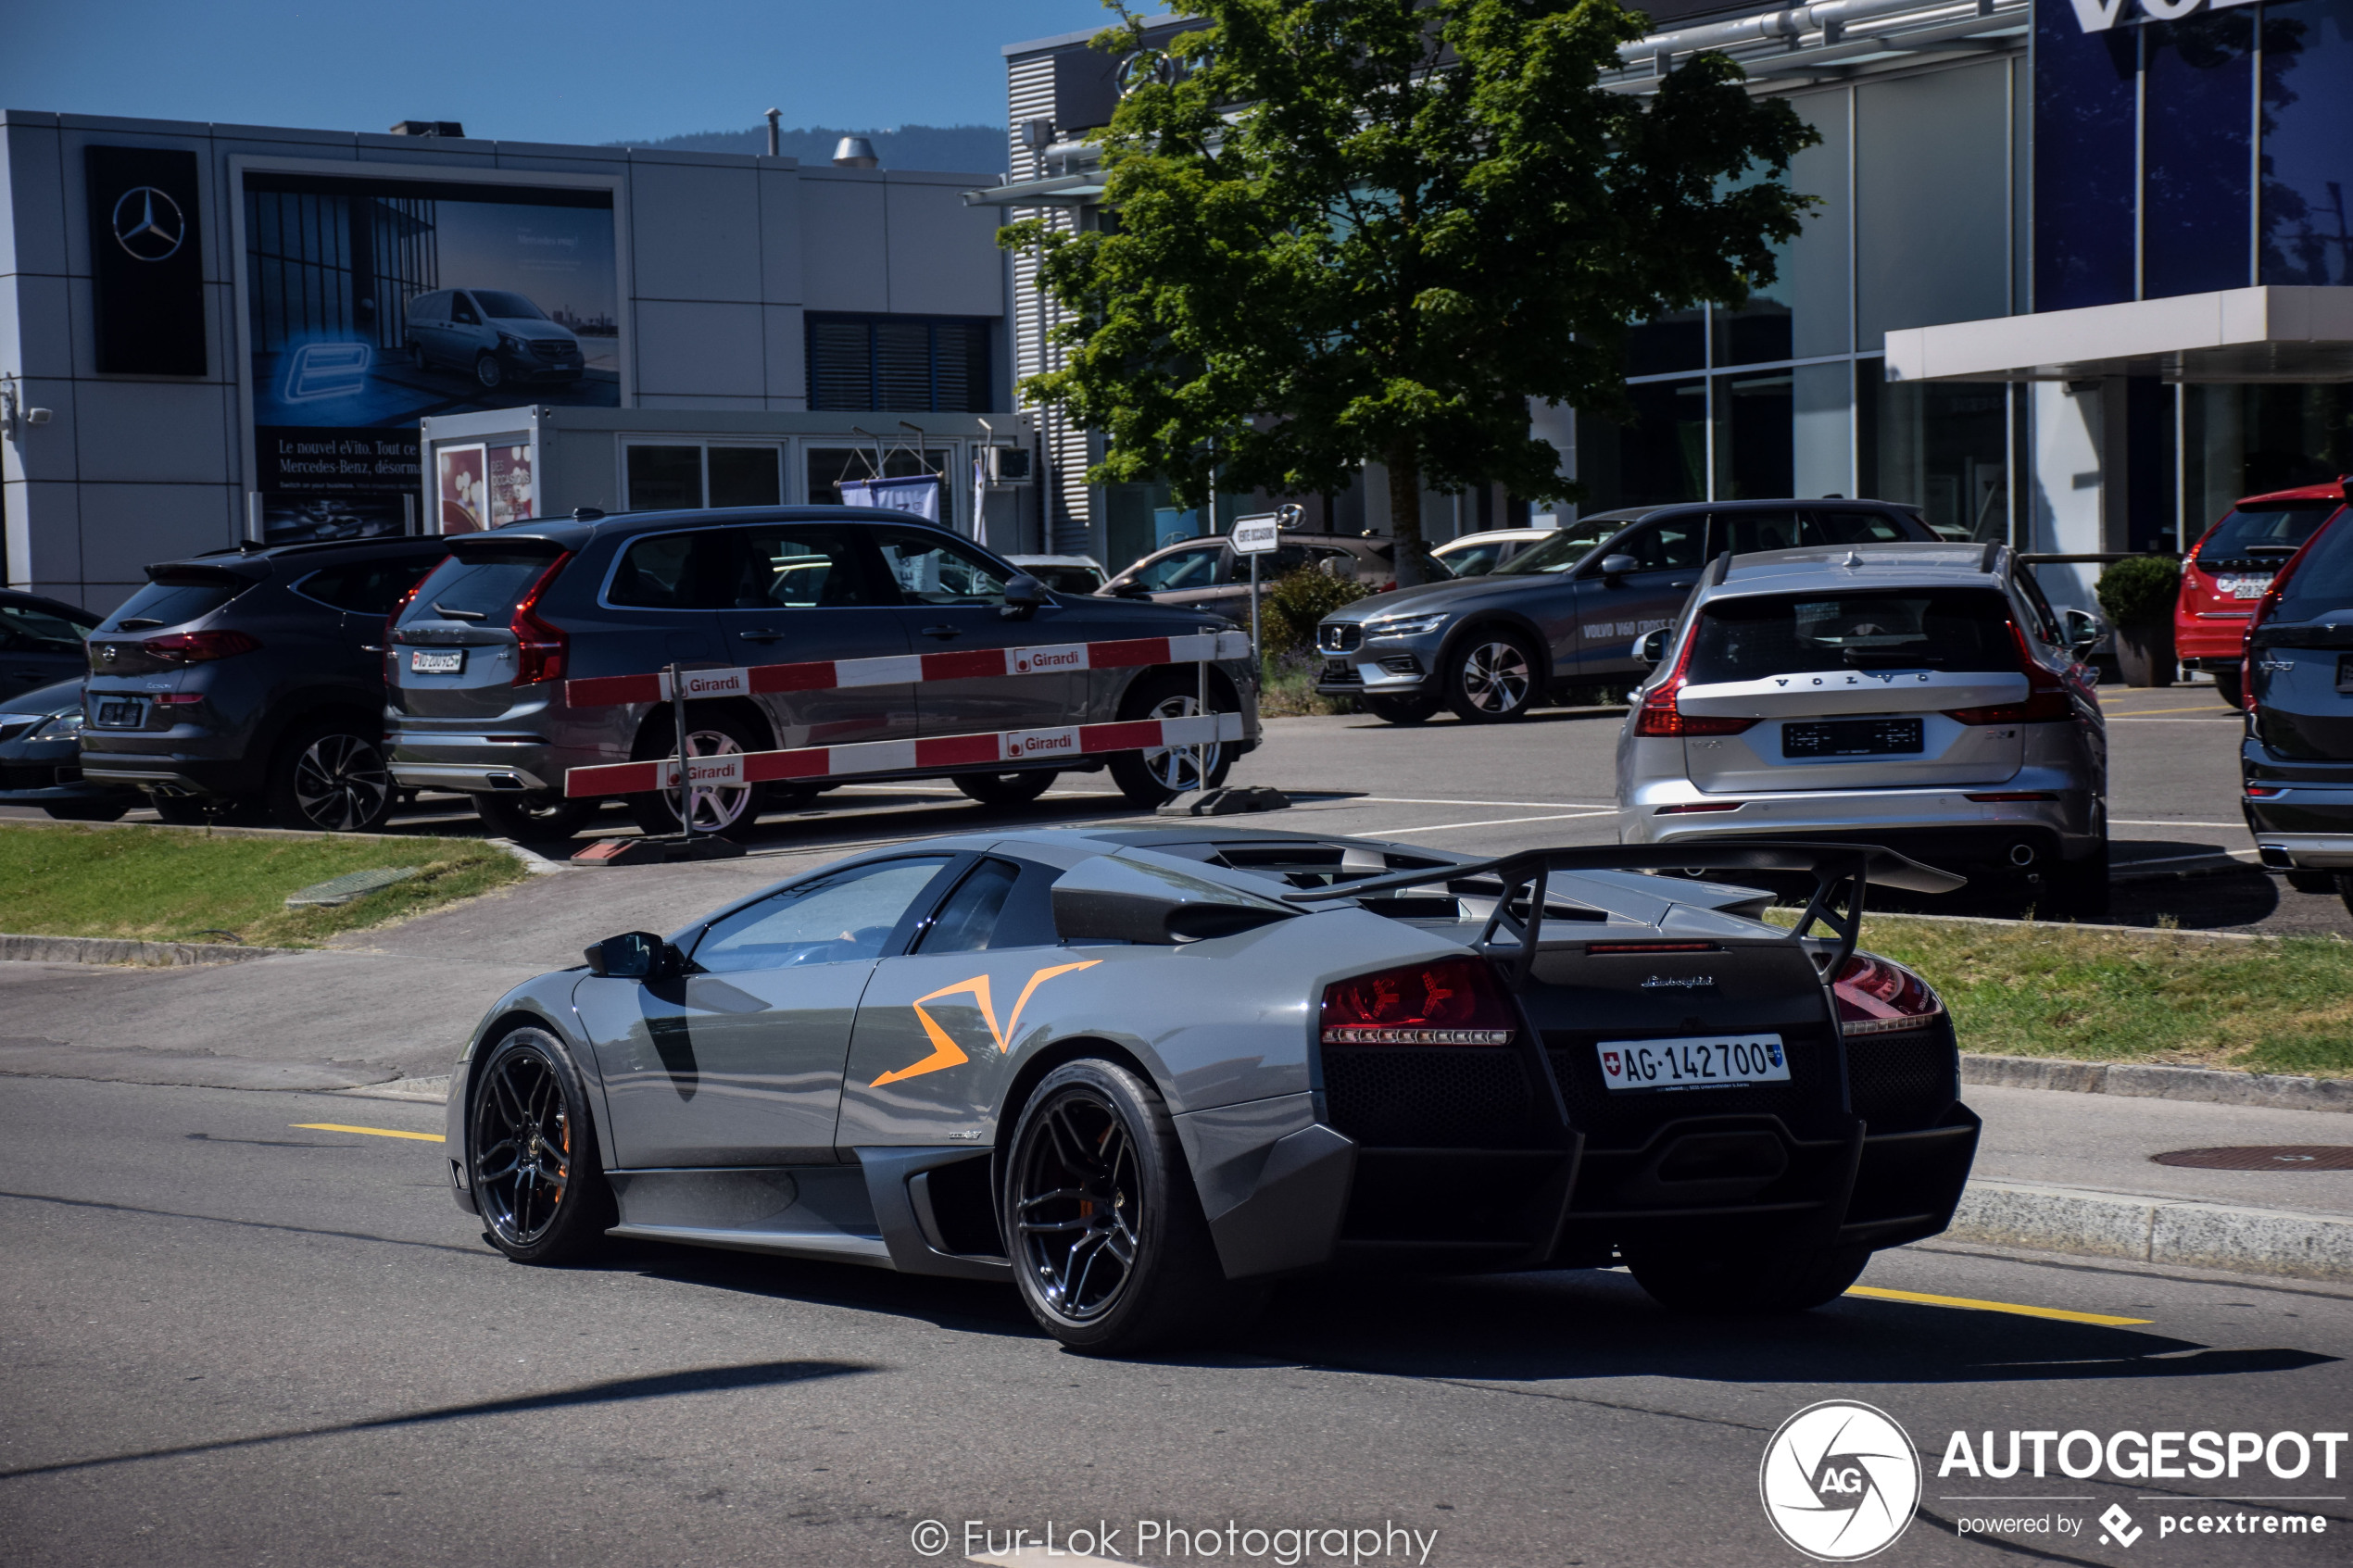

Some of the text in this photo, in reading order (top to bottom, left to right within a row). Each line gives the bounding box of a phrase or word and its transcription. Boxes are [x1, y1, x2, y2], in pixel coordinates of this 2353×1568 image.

[279, 439, 416, 455] Le nouvel eVito. Tout ce
[280, 459, 372, 475] Mercedes-Benz,
[1583, 622, 1615, 639] VOLVO
[1616, 621, 1636, 636] V60
[1033, 651, 1079, 667] Girardi
[690, 676, 740, 692] Girardi
[1775, 672, 1930, 687] VOLVO
[1026, 734, 1072, 750] Girardi
[688, 764, 736, 780] Girardi
[1642, 975, 1716, 989] Lamborghini
